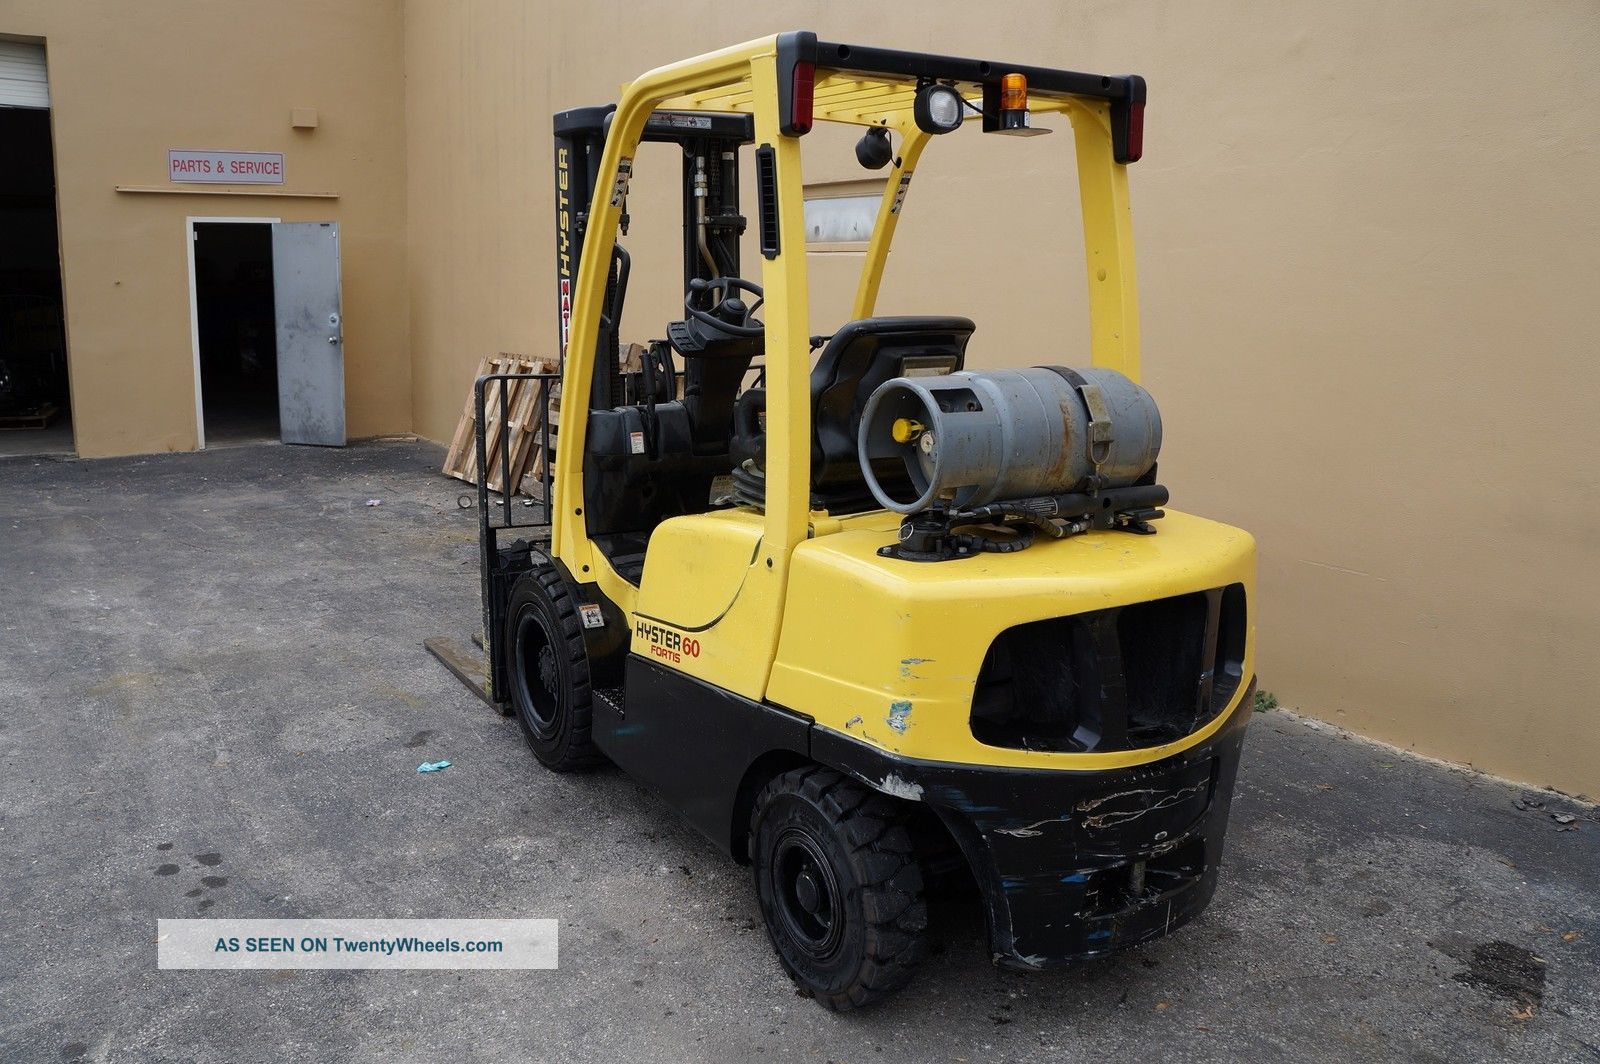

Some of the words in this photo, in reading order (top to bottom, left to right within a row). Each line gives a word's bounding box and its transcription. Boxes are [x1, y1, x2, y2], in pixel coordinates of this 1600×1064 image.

[172, 159, 211, 173] PARTS
[216, 160, 225, 174] &
[230, 161, 280, 175] SERVICE
[558, 148, 571, 277] HYSTER
[636, 620, 681, 652] HYSTER
[682, 636, 700, 658] 60
[650, 644, 681, 664] FORTIS
